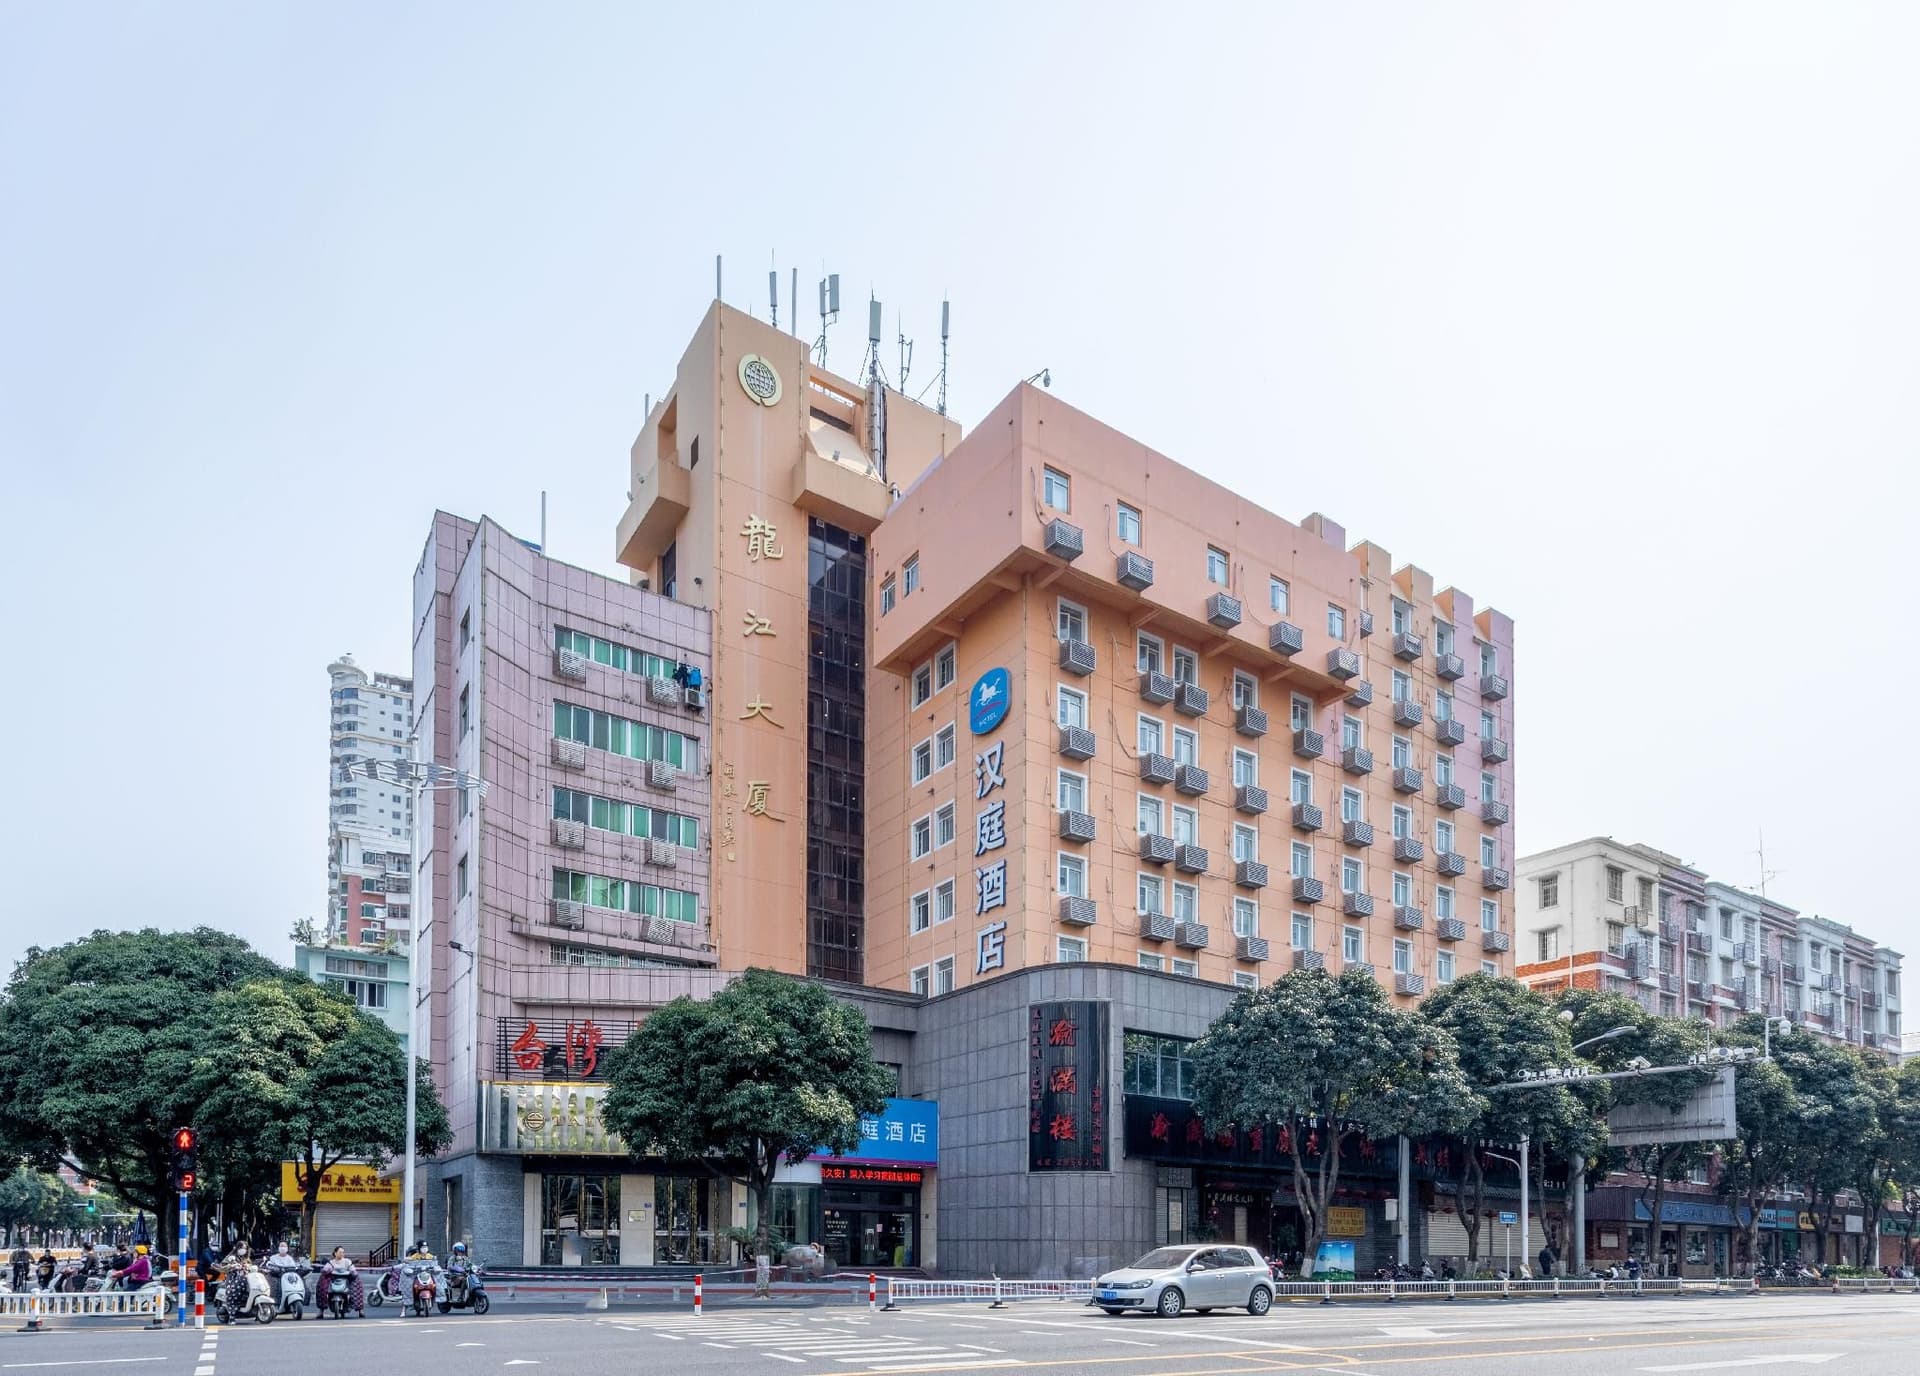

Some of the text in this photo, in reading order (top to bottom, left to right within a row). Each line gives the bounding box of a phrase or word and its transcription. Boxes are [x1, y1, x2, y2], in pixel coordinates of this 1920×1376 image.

[975, 741, 1007, 976] 汉庭酒店
[183, 1174, 193, 1188] 2
